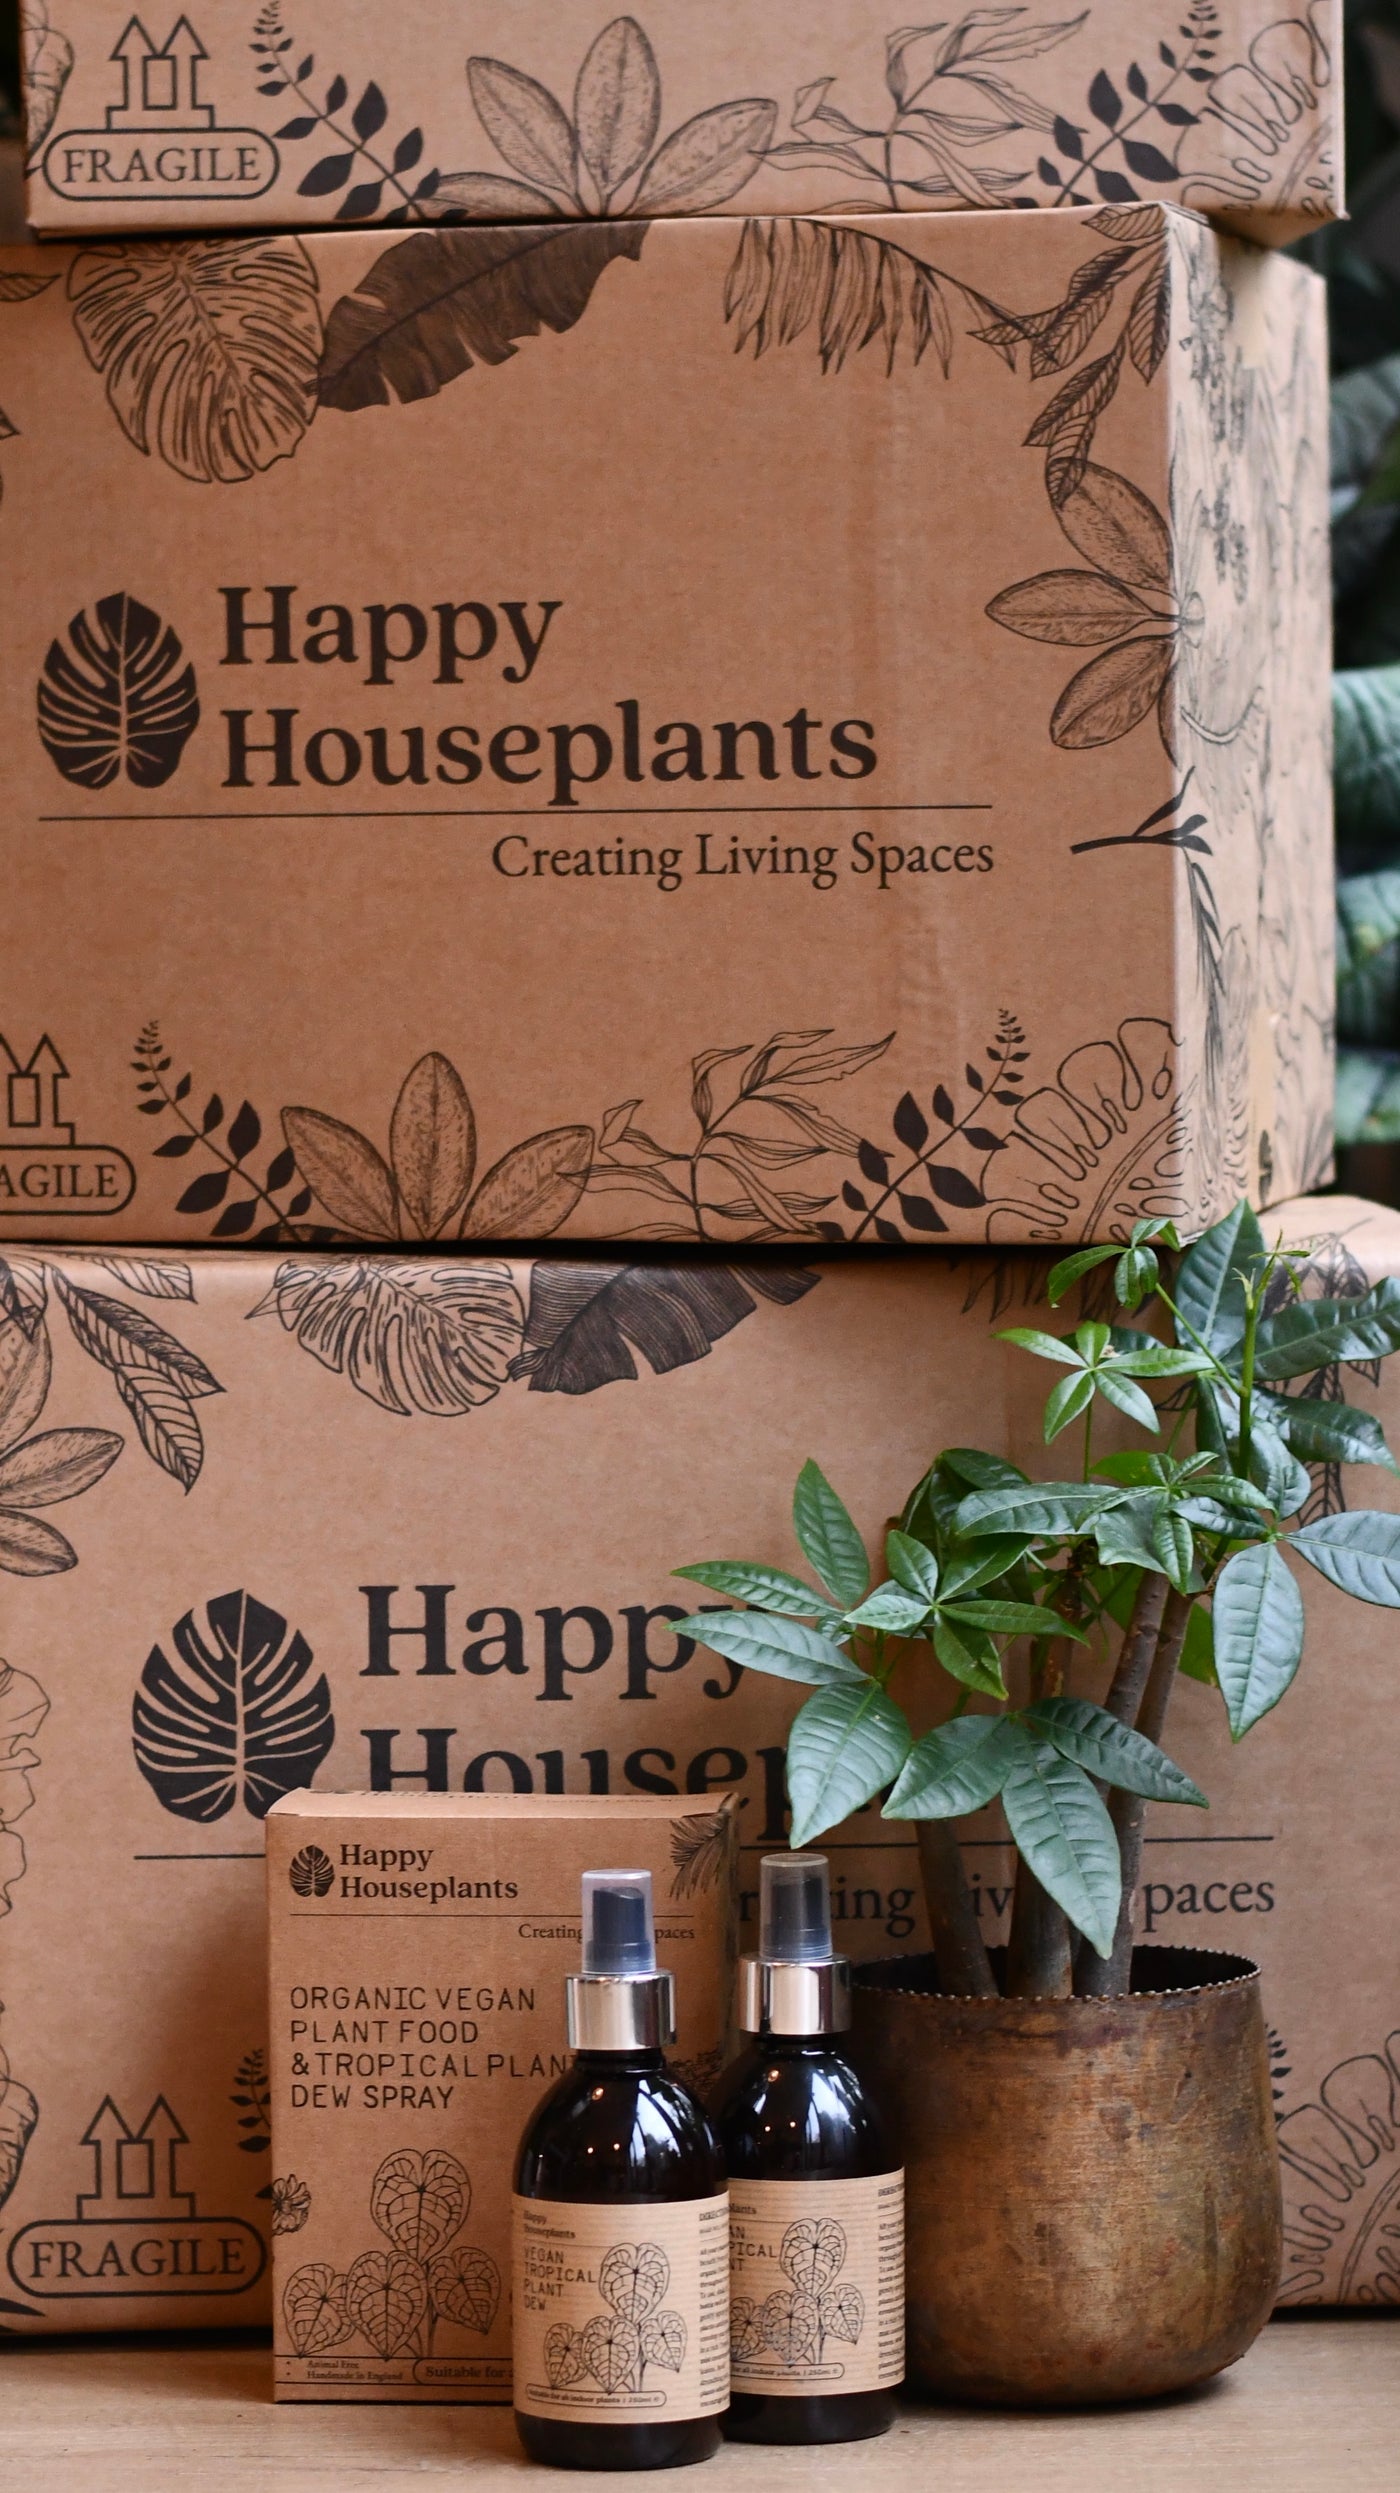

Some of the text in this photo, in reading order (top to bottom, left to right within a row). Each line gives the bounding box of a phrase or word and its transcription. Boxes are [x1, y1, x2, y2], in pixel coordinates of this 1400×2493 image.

[63, 145, 260, 184] FRAGILE
[218, 586, 563, 685] Happy
[220, 699, 878, 806] Houseplants
[492, 831, 994, 891] Creating Living Spaces
[340, 1844, 434, 1873] Happy
[340, 1876, 518, 1904] Houseplants
[1142, 1881, 1275, 1933] paces
[655, 1928, 695, 1944] paces
[291, 1987, 534, 2011] ORGANIC VEGAN
[291, 2020, 478, 2044] PLANT FOOD
[315, 2053, 477, 2078] TROPICAL
[292, 2085, 454, 2109] DEW SPRAY
[30, 2239, 247, 2278] FRAGILE
[524, 2245, 564, 2264] VEGAN
[524, 2261, 597, 2283] TROPICAL
[524, 2278, 564, 2297] PLANT
[524, 2295, 546, 2311] DEW
